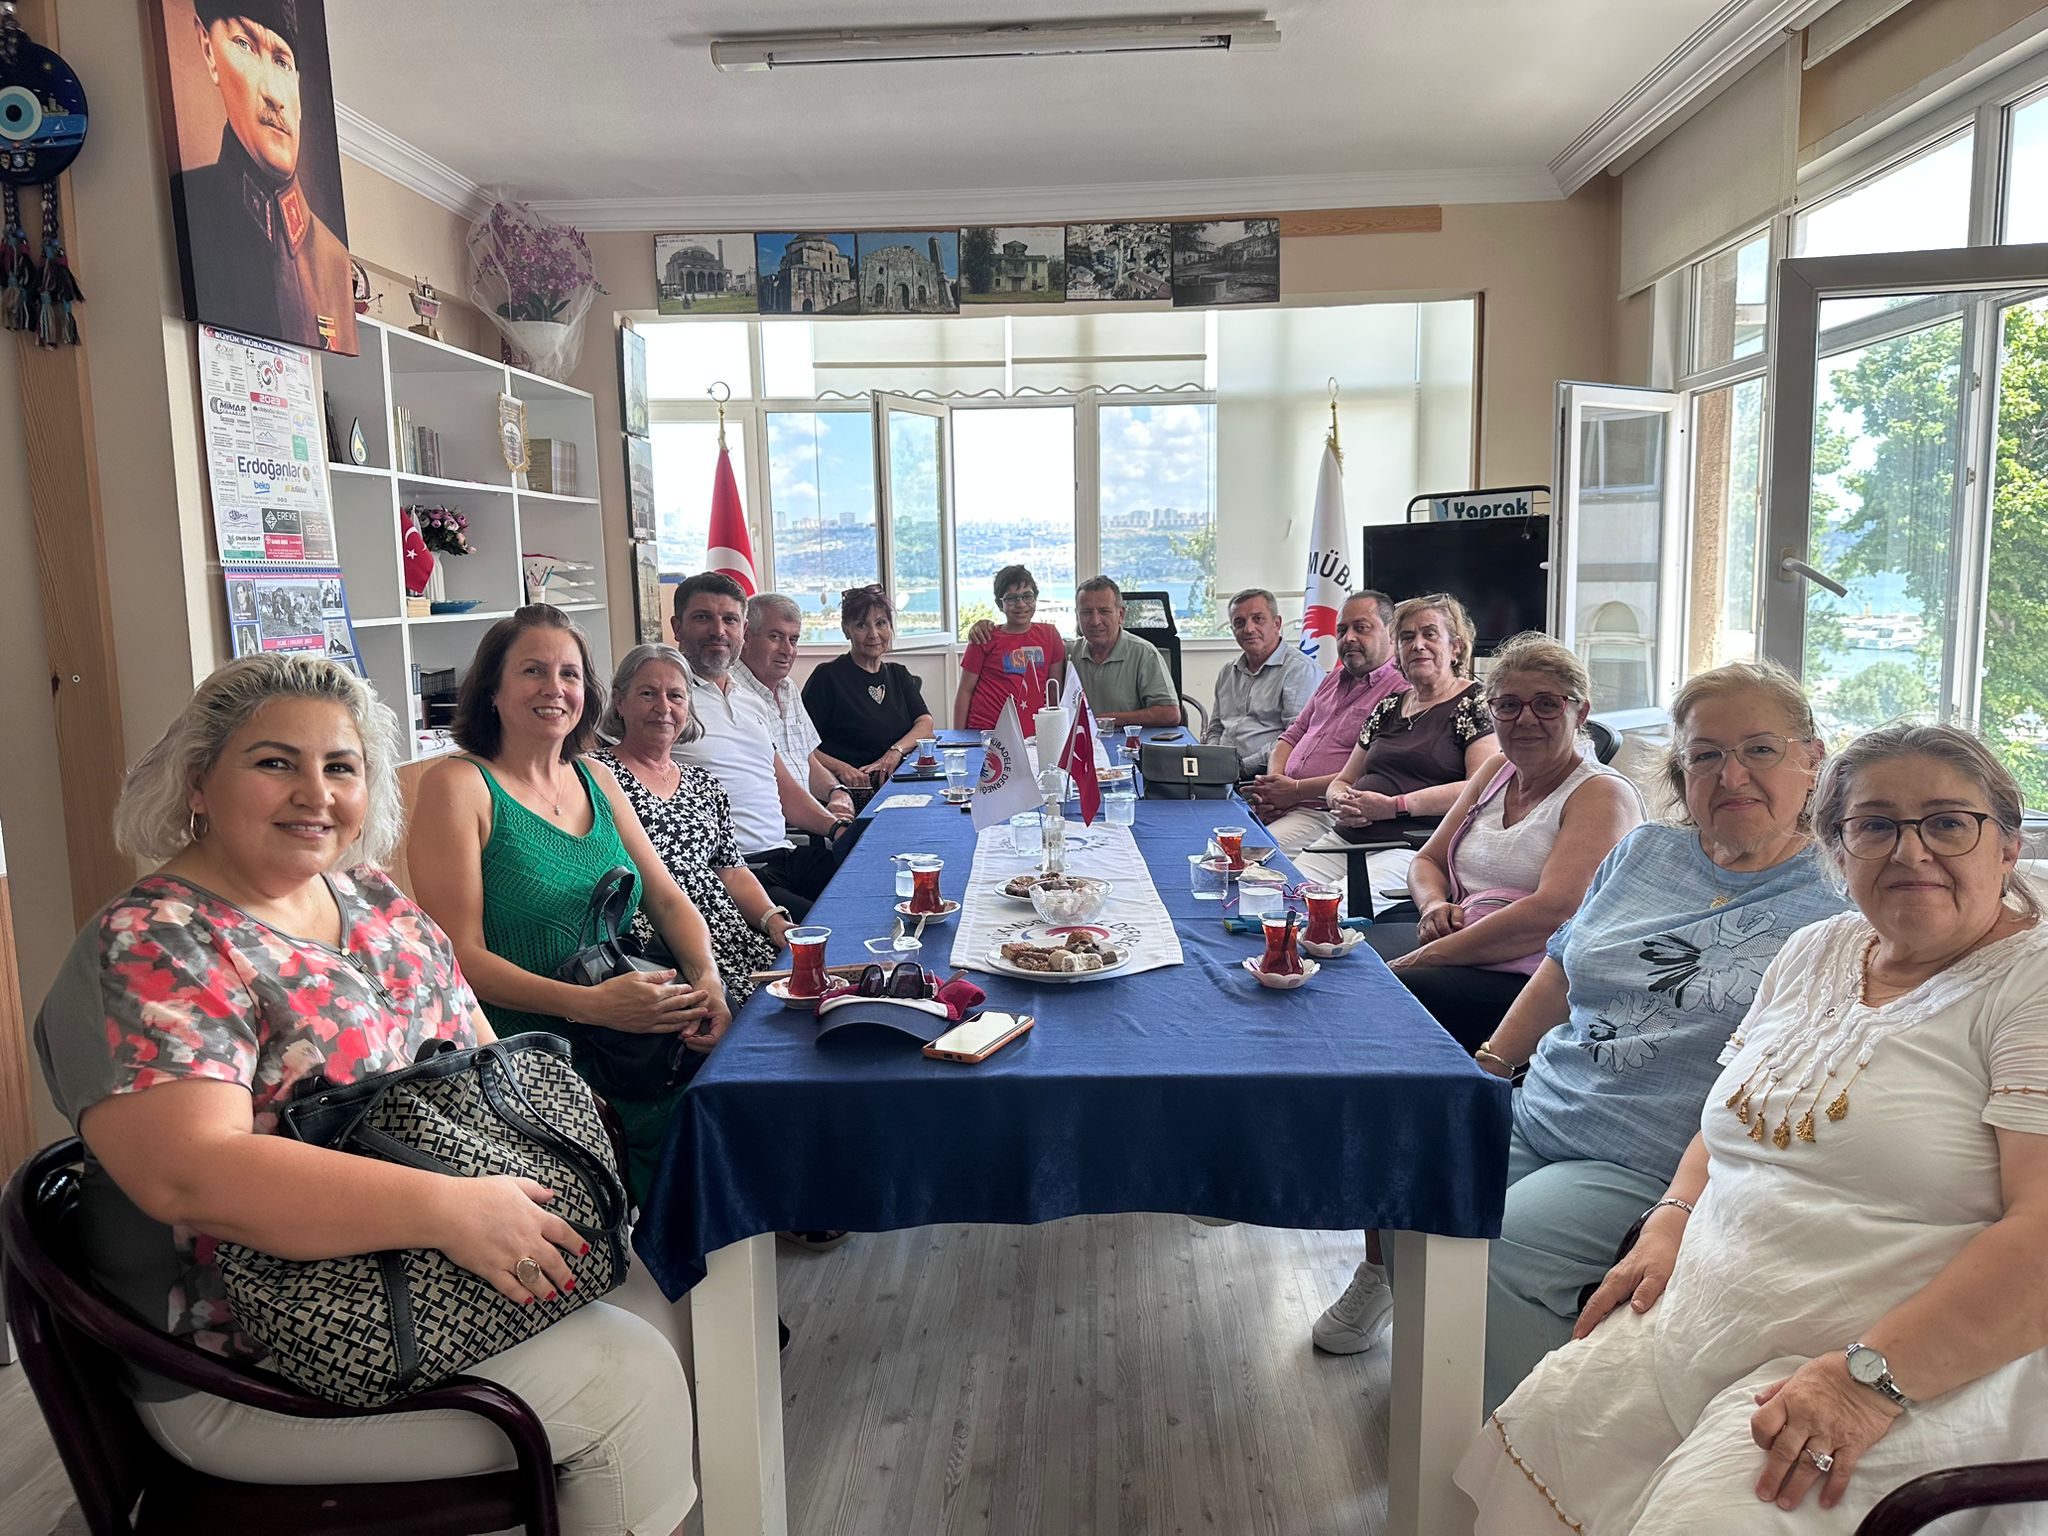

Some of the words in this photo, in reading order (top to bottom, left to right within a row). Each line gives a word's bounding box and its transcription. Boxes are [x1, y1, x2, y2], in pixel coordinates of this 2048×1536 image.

[214, 330, 240, 343] BÜYÜK
[259, 395, 281, 407] 2023
[237, 456, 301, 480] Erdoğanlar
[253, 480, 271, 490] beko
[1453, 497, 1529, 519] Yaprak
[276, 511, 297, 521] EREKE
